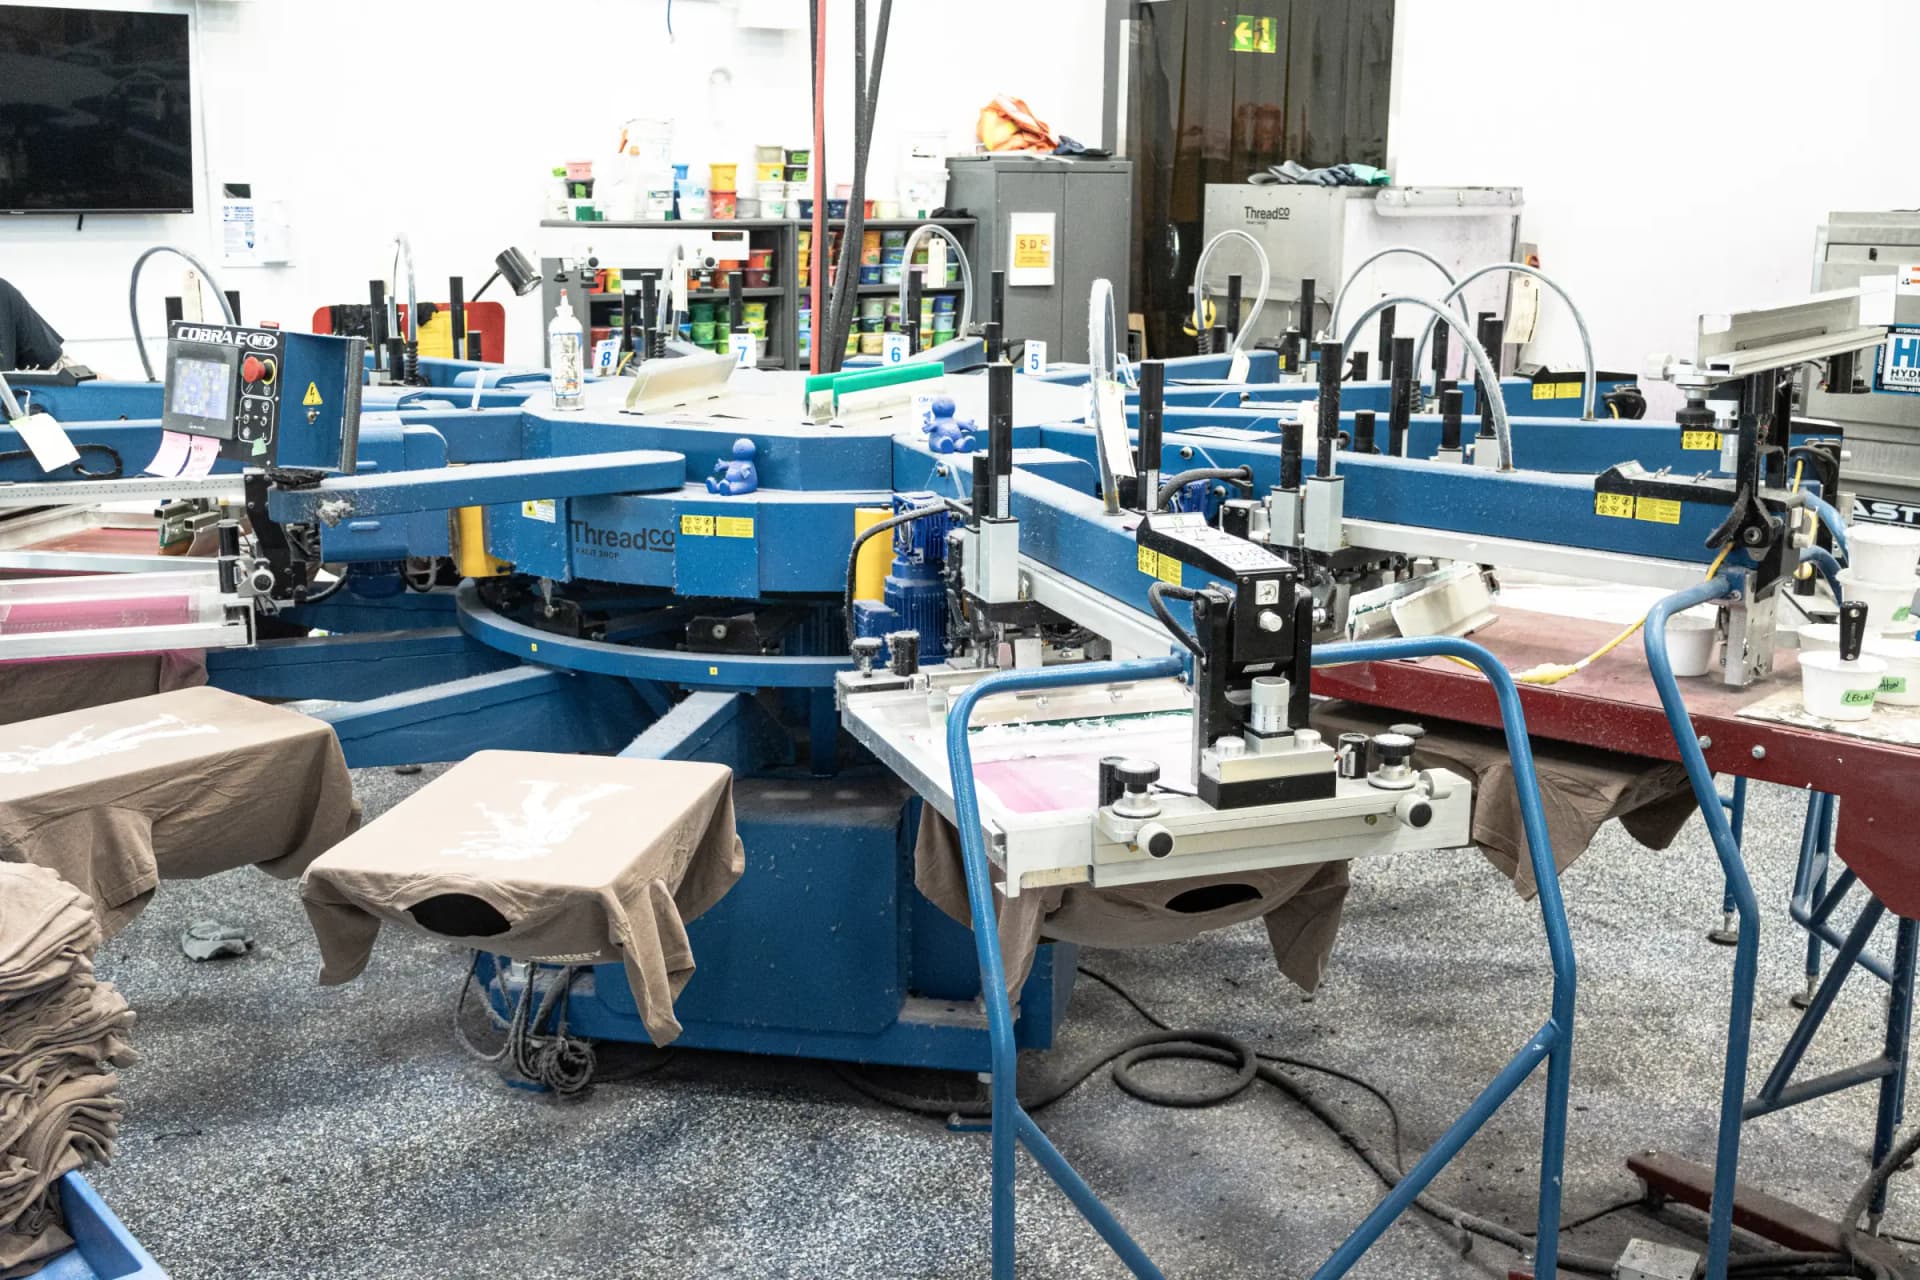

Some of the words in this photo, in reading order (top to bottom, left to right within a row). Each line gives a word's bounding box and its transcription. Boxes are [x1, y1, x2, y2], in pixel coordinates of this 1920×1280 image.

[177, 326, 233, 344] COBRA
[235, 332, 248, 346] E
[600, 351, 611, 367] 8
[736, 345, 748, 362] 7
[891, 346, 901, 363] 6
[1031, 353, 1040, 370] 5
